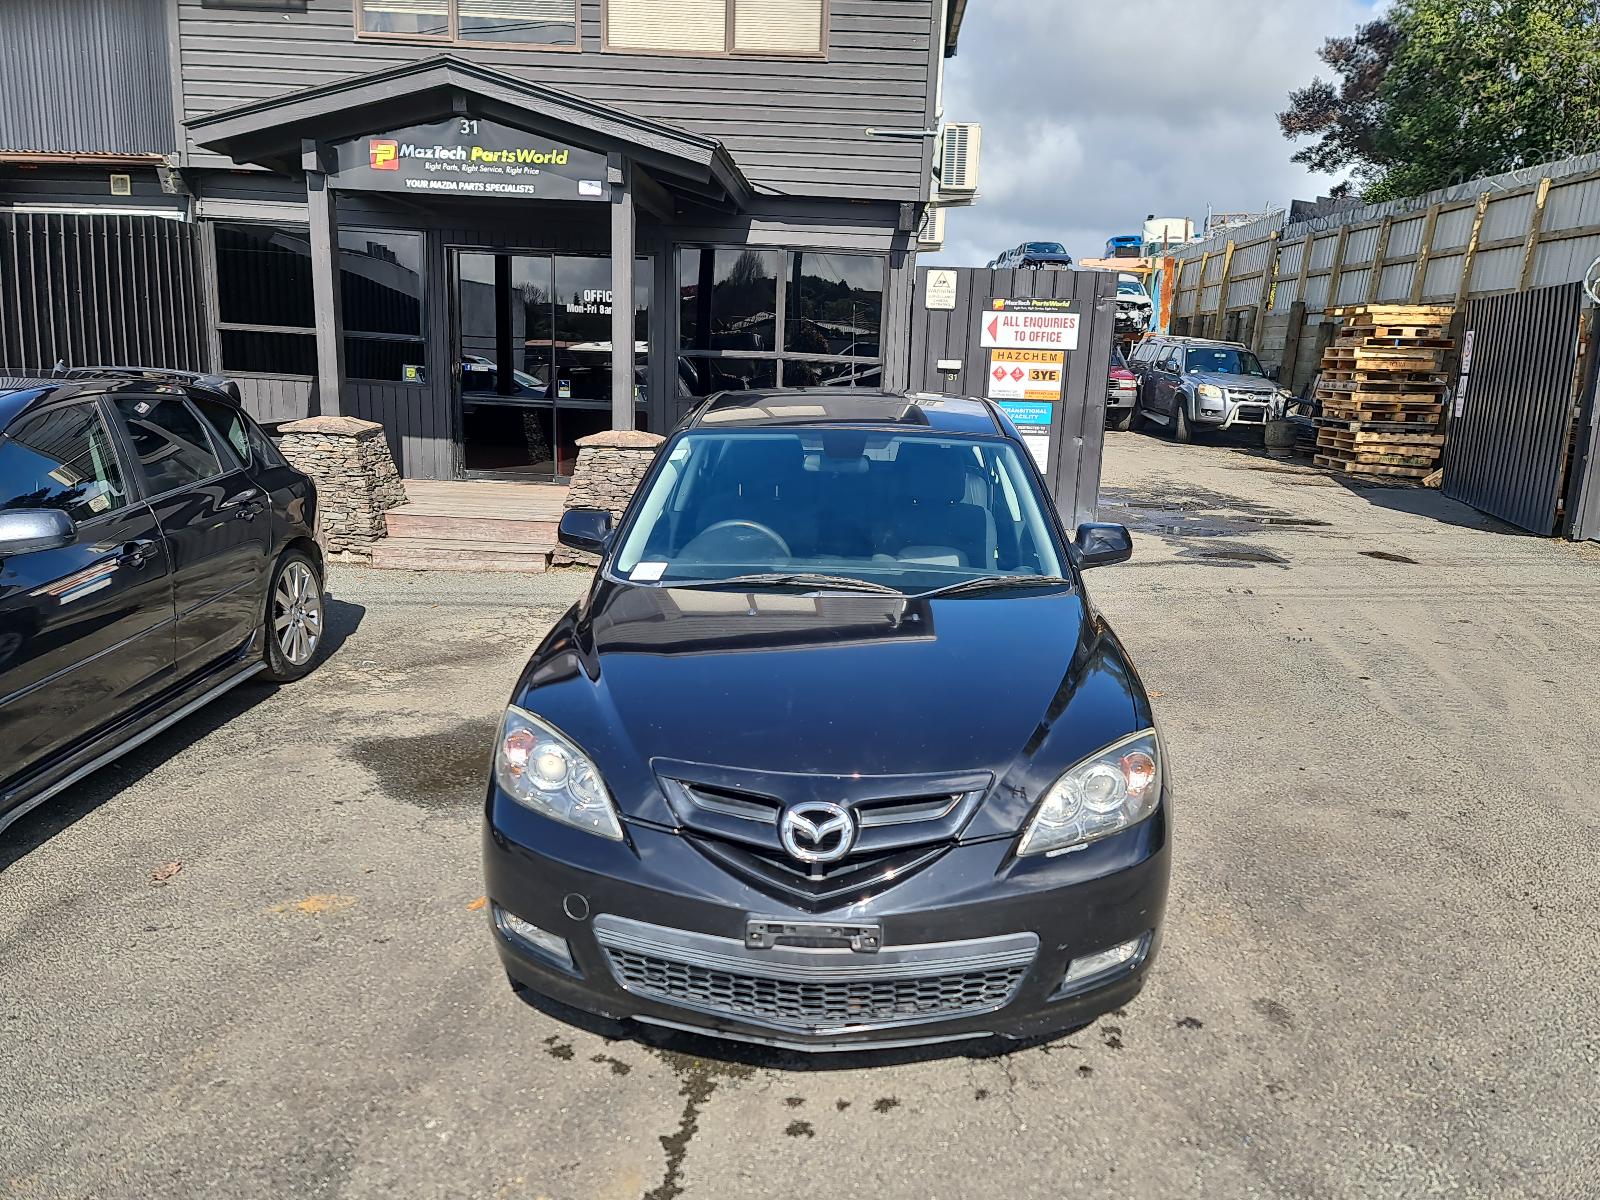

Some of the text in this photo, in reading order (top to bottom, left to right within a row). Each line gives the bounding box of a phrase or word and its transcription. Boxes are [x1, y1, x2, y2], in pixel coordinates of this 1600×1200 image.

[460, 119, 478, 134] 31
[399, 143, 568, 165] MazTech PartsWorld
[425, 162, 442, 172] Right
[442, 163, 460, 172] Parts,
[461, 164, 478, 174] Right
[479, 165, 504, 174] Service,
[505, 166, 522, 176] Right
[405, 179, 535, 194] YOUR MAZDA PARTS SPECIALISTS
[583, 289, 613, 303] OFFIC
[566, 303, 598, 314] Mon-Fri
[1002, 315, 1076, 329] ALL ENQUIRIES
[1014, 330, 1062, 343] TO OFFICE
[997, 351, 1058, 362] HAZCHEM
[947, 373, 958, 381] 31
[1031, 370, 1057, 381] 3YE
